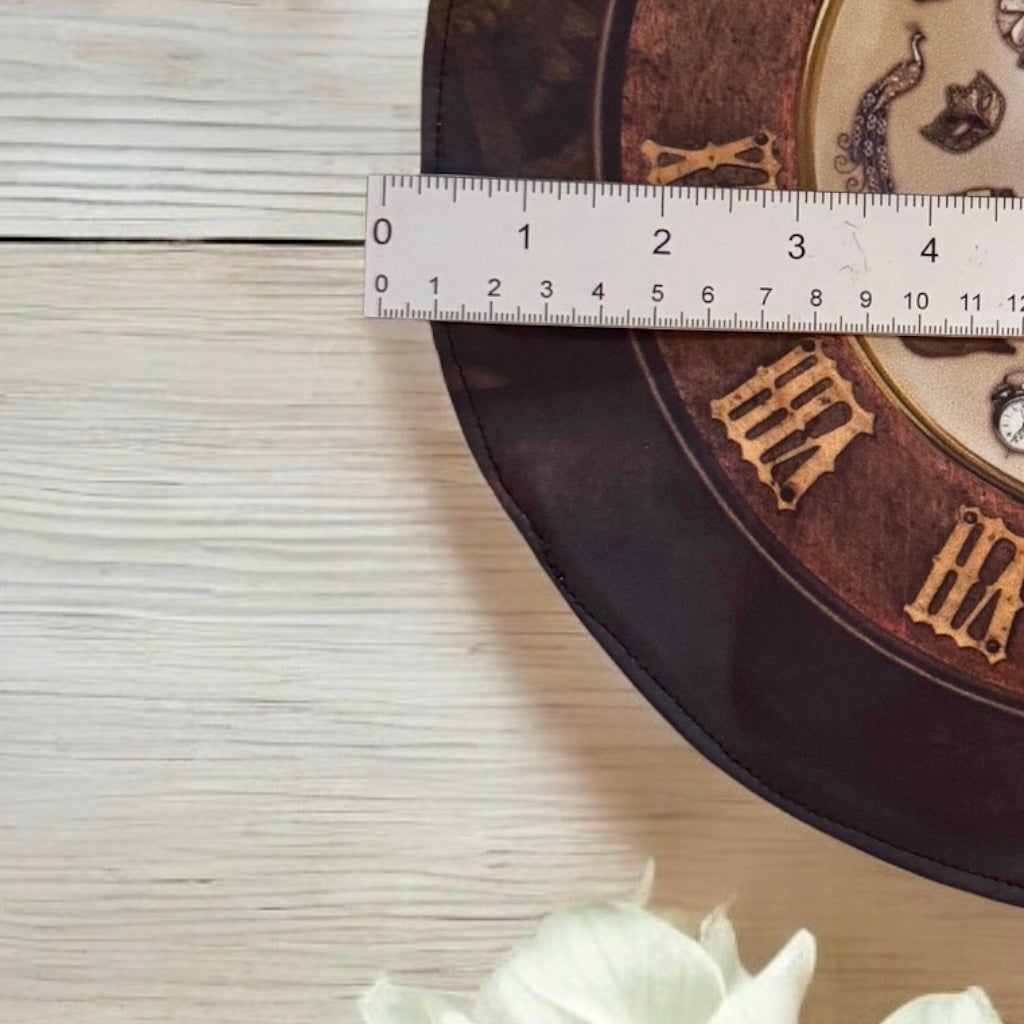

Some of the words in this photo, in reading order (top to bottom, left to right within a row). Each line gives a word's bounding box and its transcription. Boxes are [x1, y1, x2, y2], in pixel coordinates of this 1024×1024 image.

[372, 217, 393, 246] 0
[518, 223, 530, 250] 1
[652, 228, 672, 256] 2
[787, 233, 806, 260] 3
[920, 237, 939, 263] 4
[374, 273, 389, 294] 0
[429, 276, 439, 295] 1
[487, 278, 502, 297] 2
[540, 279, 554, 299] 3
[591, 281, 606, 301] 4
[651, 283, 664, 303] 5
[701, 285, 715, 304] 6
[759, 287, 773, 306] 7
[809, 288, 823, 307] 8
[859, 290, 873, 309] 9
[903, 291, 929, 310] 10
[960, 292, 981, 312] 11
